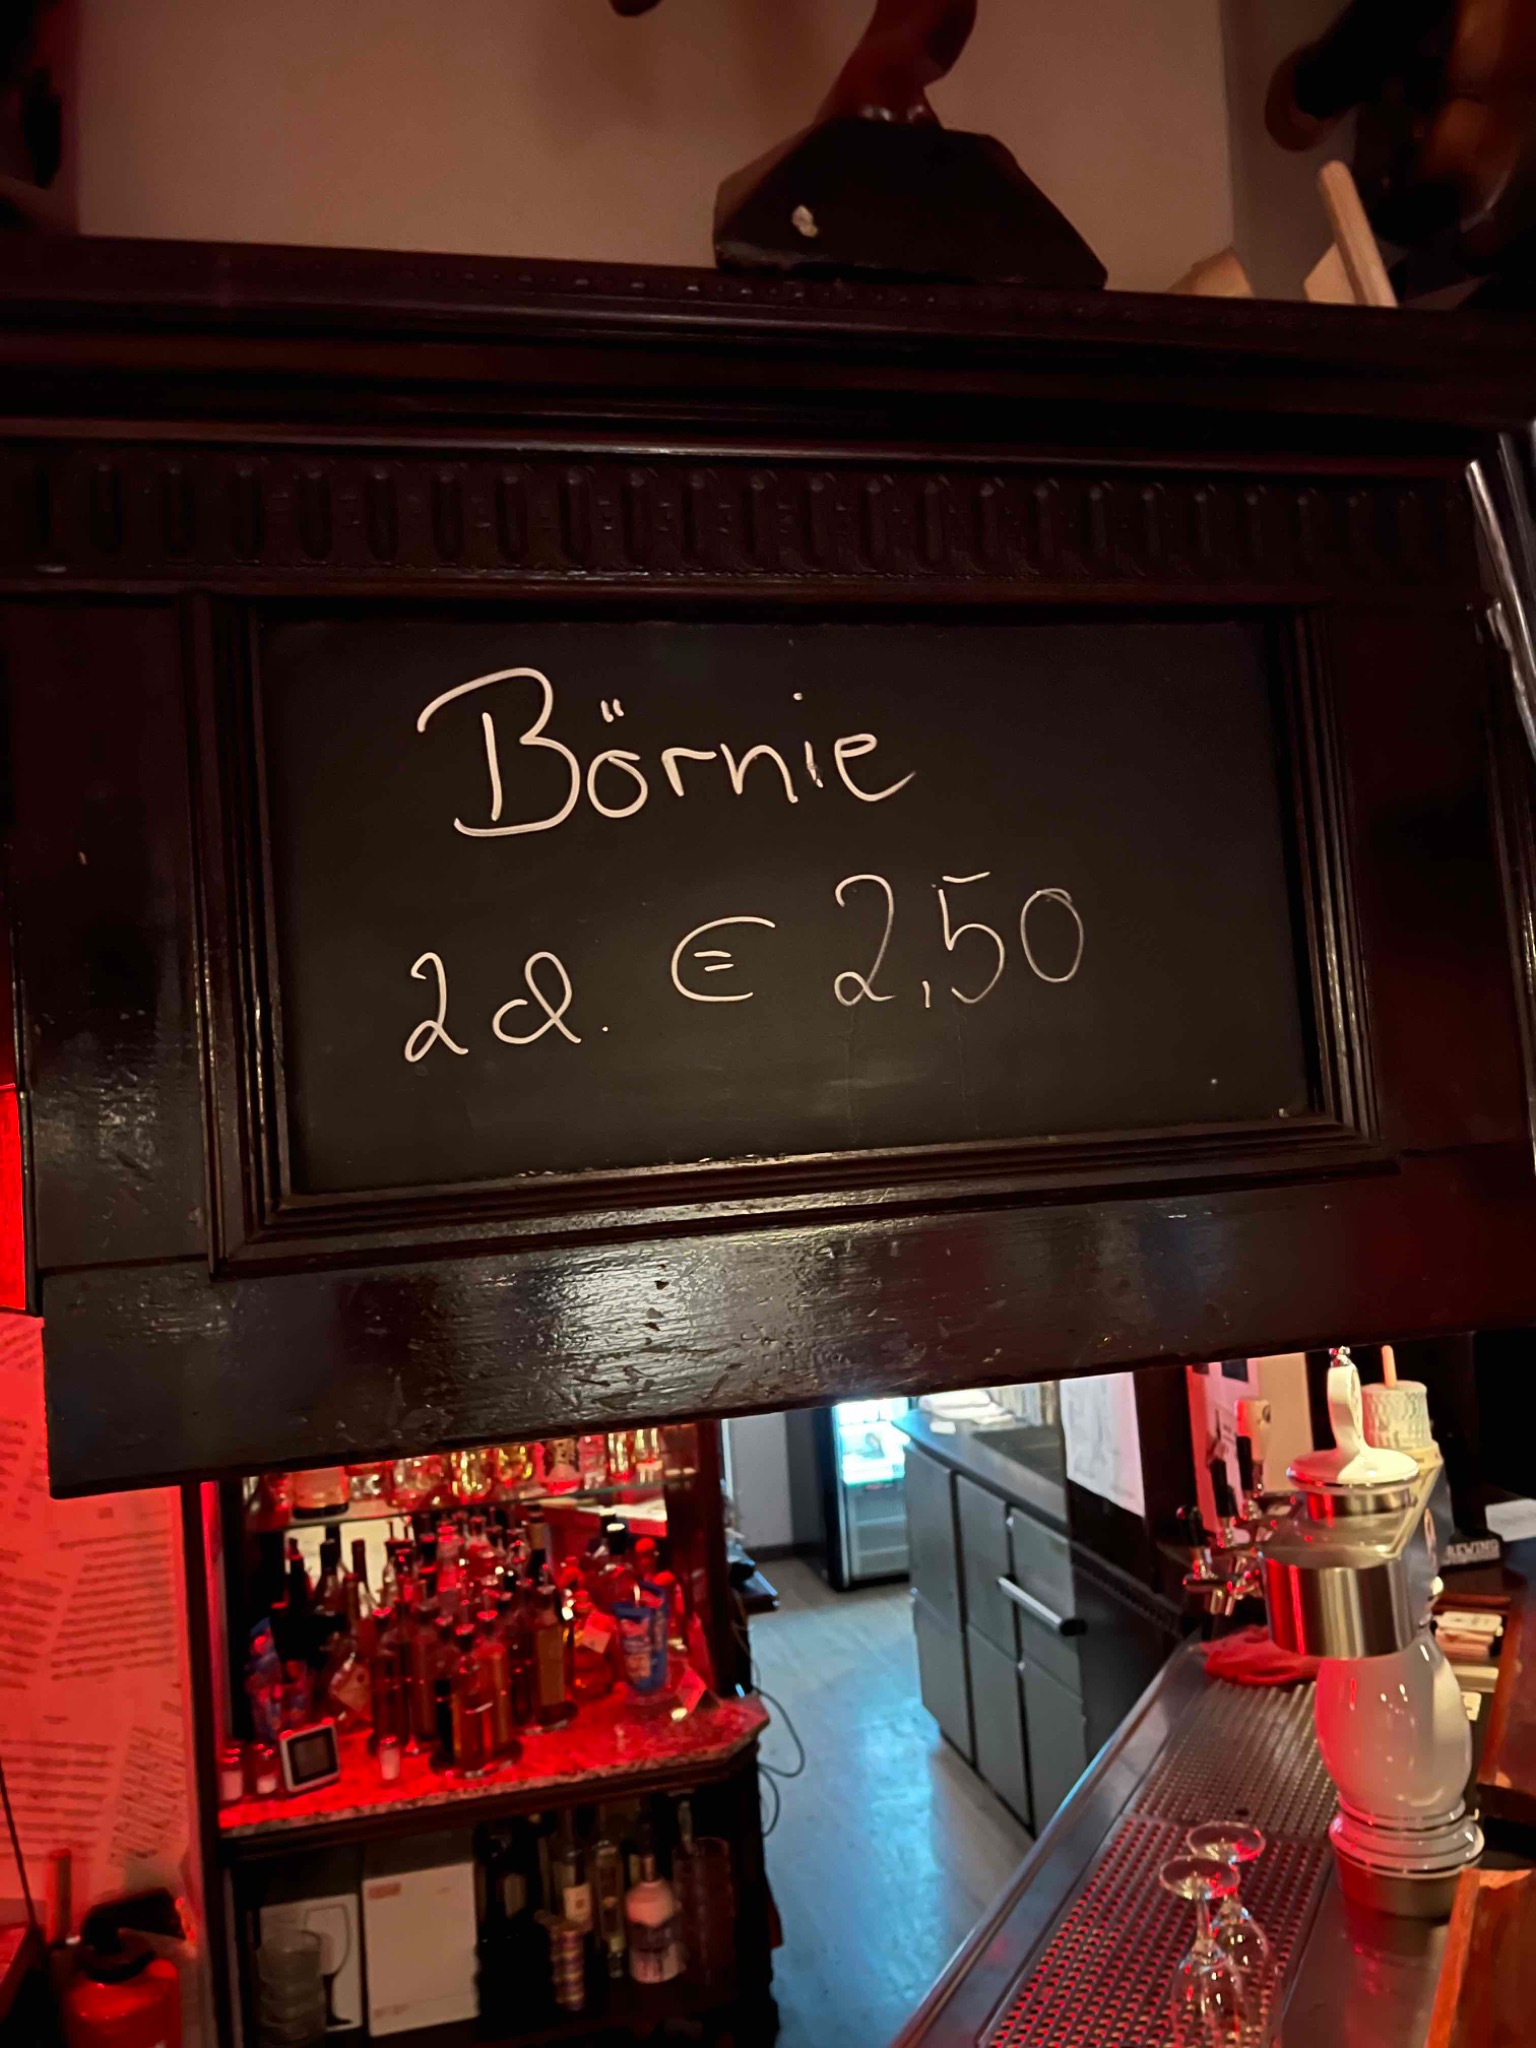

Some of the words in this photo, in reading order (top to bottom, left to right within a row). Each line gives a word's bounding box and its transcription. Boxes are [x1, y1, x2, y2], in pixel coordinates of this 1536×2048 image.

[416, 667, 915, 837] Börnie
[404, 951, 469, 1063] 2
[670, 915, 776, 1002] €
[833, 871, 1084, 1009] 2,50
